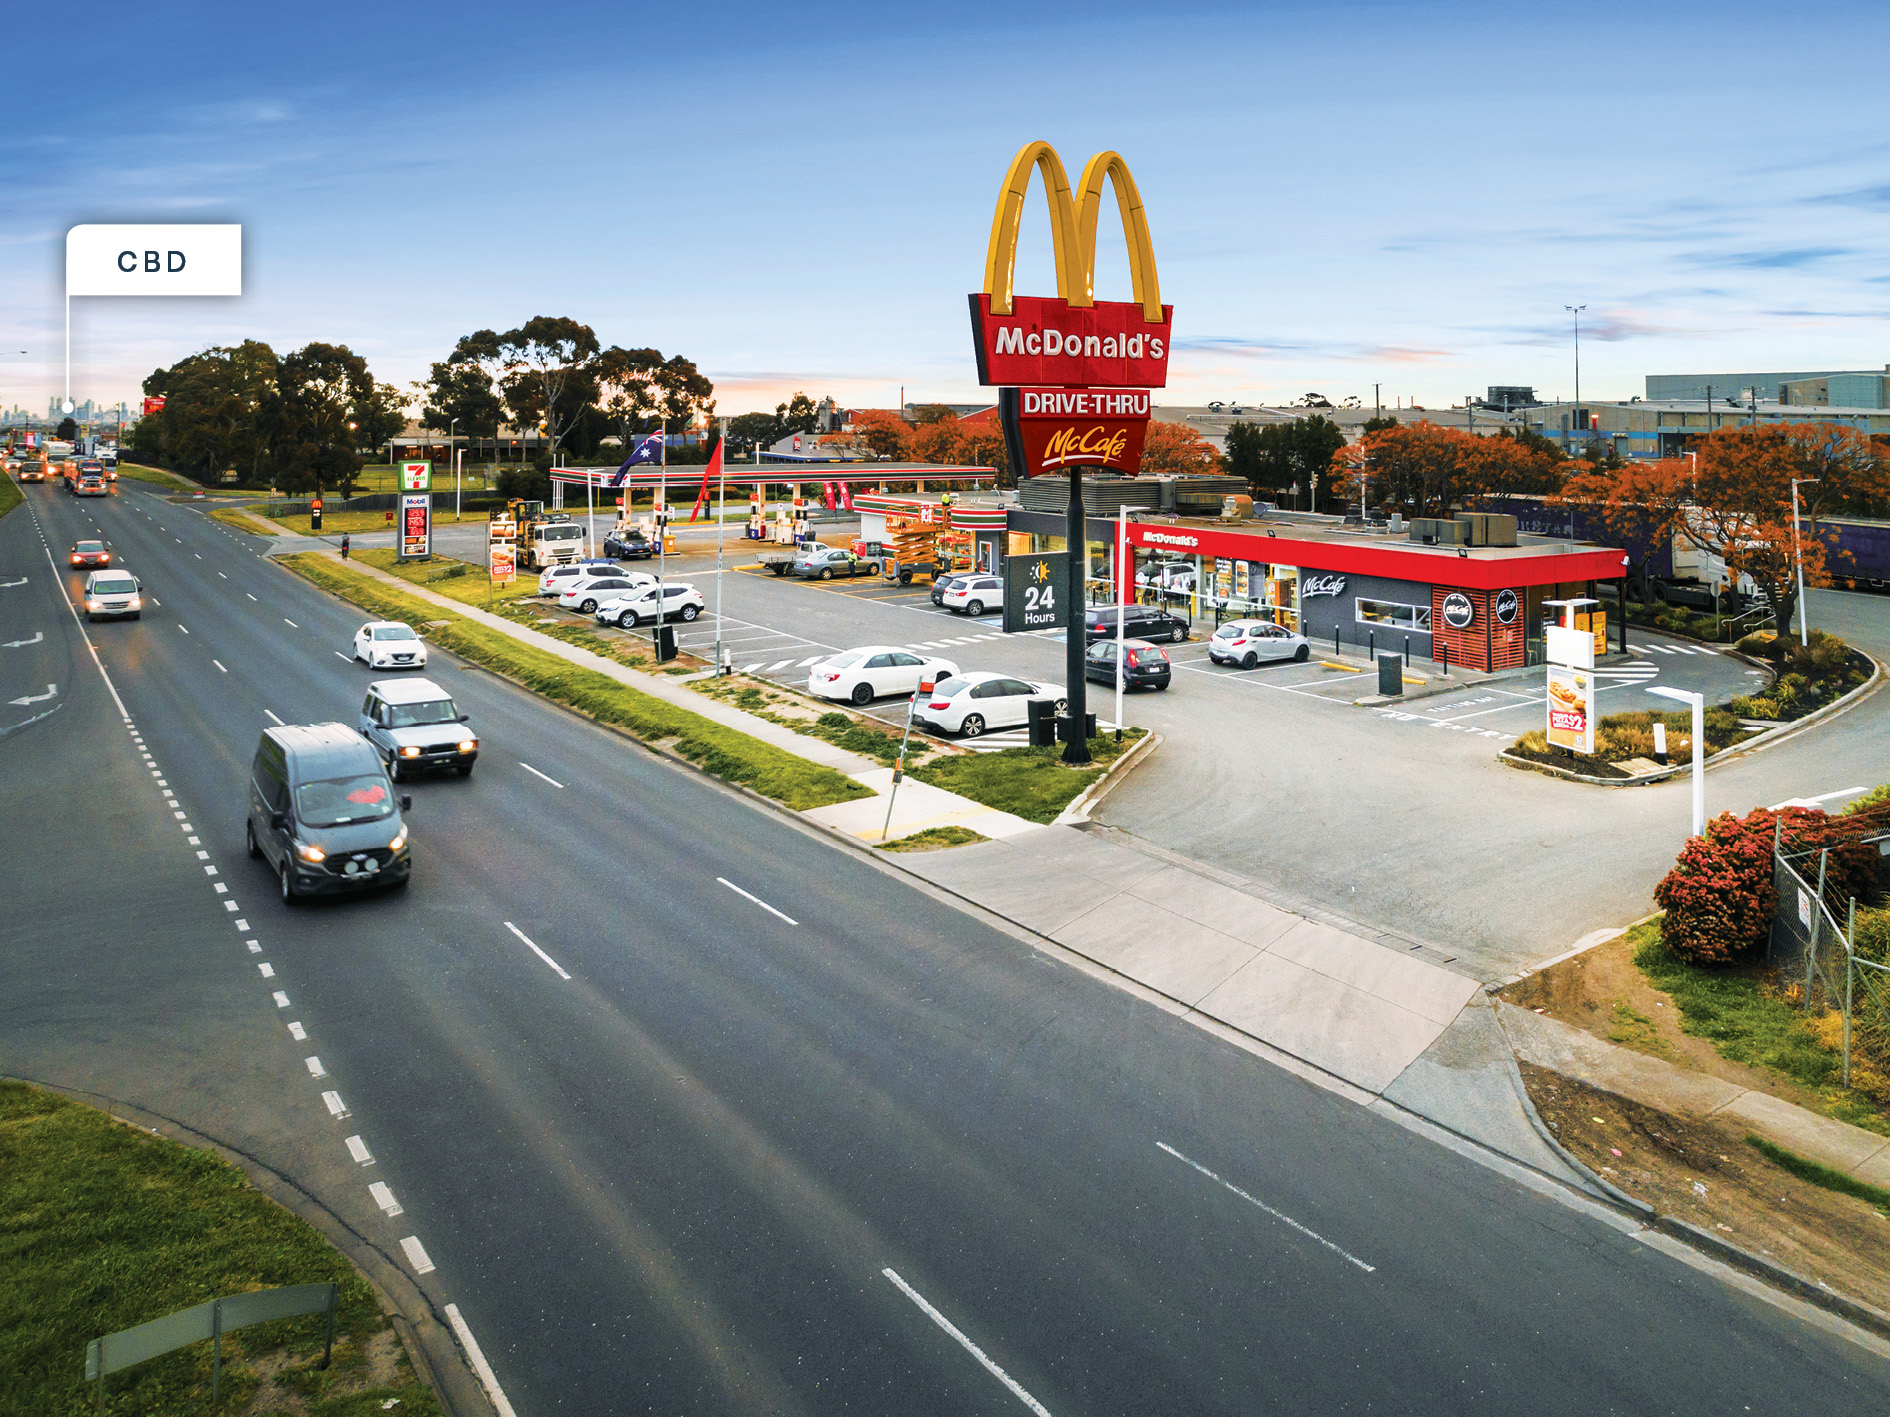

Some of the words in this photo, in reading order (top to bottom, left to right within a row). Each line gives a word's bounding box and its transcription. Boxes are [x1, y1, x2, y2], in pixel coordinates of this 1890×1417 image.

[995, 326, 1165, 360] McDonald's
[1023, 392, 1149, 415] DRIVE-THRU
[1043, 425, 1128, 465] McCafé
[1143, 531, 1199, 547] McDonald's
[1302, 575, 1346, 597] McCafé
[1024, 585, 1055, 611] 24
[1024, 612, 1056, 625] Hours
